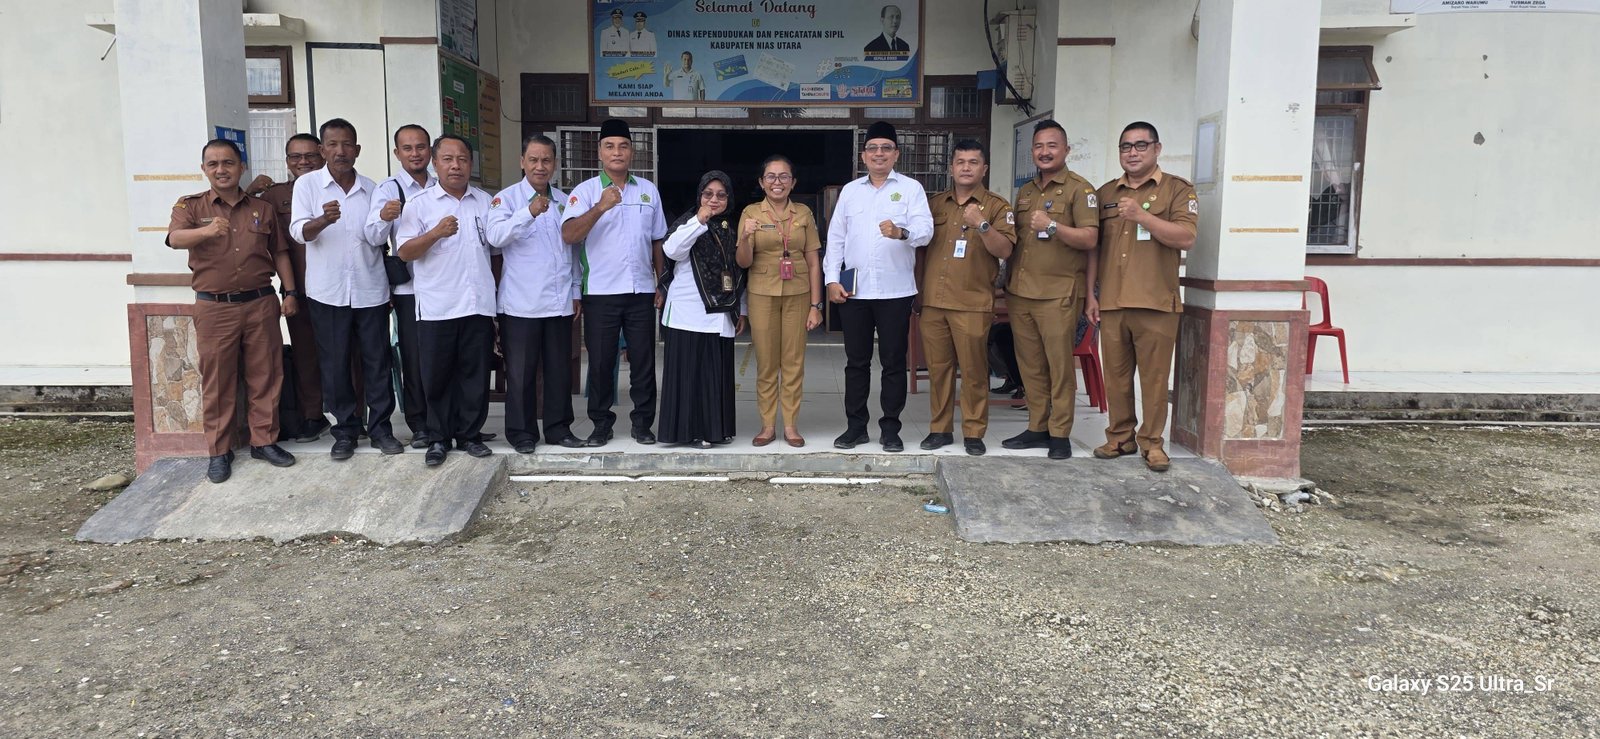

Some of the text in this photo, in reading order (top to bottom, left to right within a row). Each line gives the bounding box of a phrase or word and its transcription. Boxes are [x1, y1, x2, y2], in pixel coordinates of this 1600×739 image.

[695, 0, 817, 18] Selamat Datang
[667, 30, 845, 39] DINAS KEPENDUDUKAN DAN PENCATATAN SIPIL
[710, 41, 802, 50] KABUPATEN NIAS UTARA
